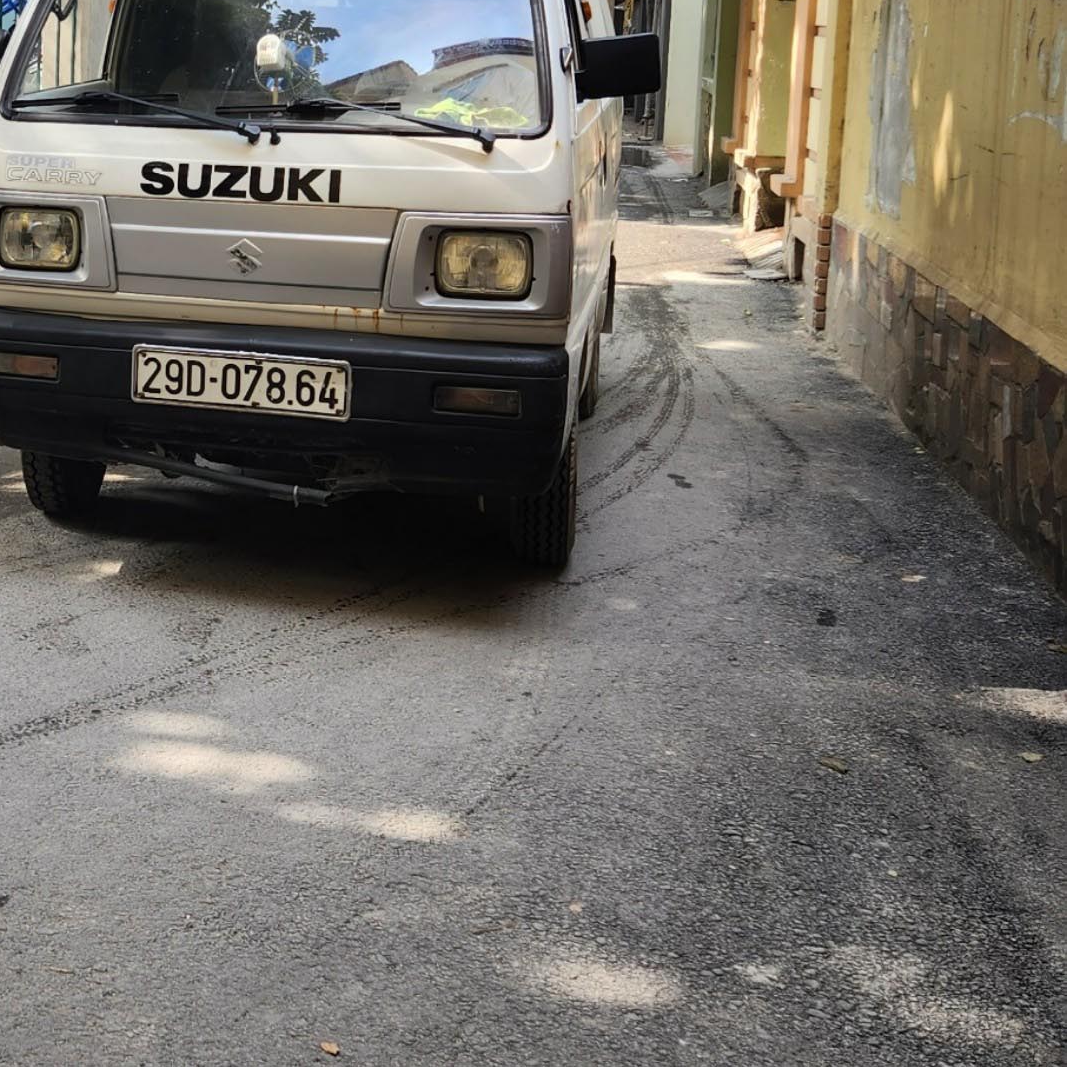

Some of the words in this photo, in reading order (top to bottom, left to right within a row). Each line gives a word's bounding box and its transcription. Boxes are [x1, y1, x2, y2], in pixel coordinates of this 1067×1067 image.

[5, 166, 103, 186] CARRY
[6, 154, 75, 169] SUPER
[140, 161, 342, 204] SUZUKI
[141, 357, 339, 410] 29D-078.64
